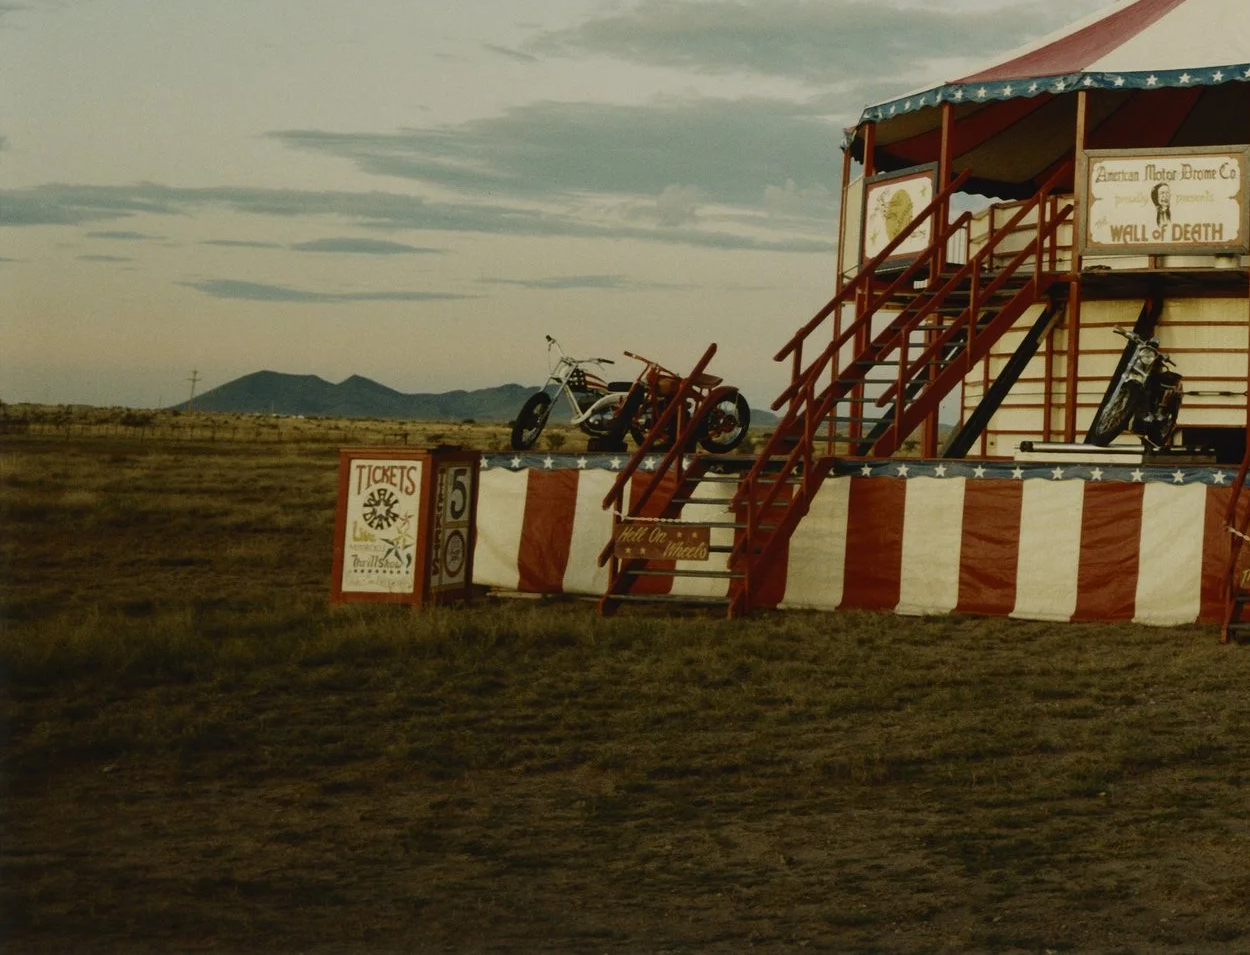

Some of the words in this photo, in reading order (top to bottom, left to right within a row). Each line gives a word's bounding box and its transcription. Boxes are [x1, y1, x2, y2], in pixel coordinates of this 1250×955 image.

[1095, 165, 1139, 183] American
[1143, 163, 1176, 182] Motor
[1110, 224, 1149, 245] WALL
[1152, 224, 1169, 241] of
[1171, 223, 1223, 243] DEATH
[356, 464, 418, 496] TICKETS
[362, 488, 400, 508] WALL
[362, 510, 399, 530] DEATH
[618, 525, 648, 542] Hell
[648, 526, 668, 543] On
[662, 541, 708, 559] Wheels
